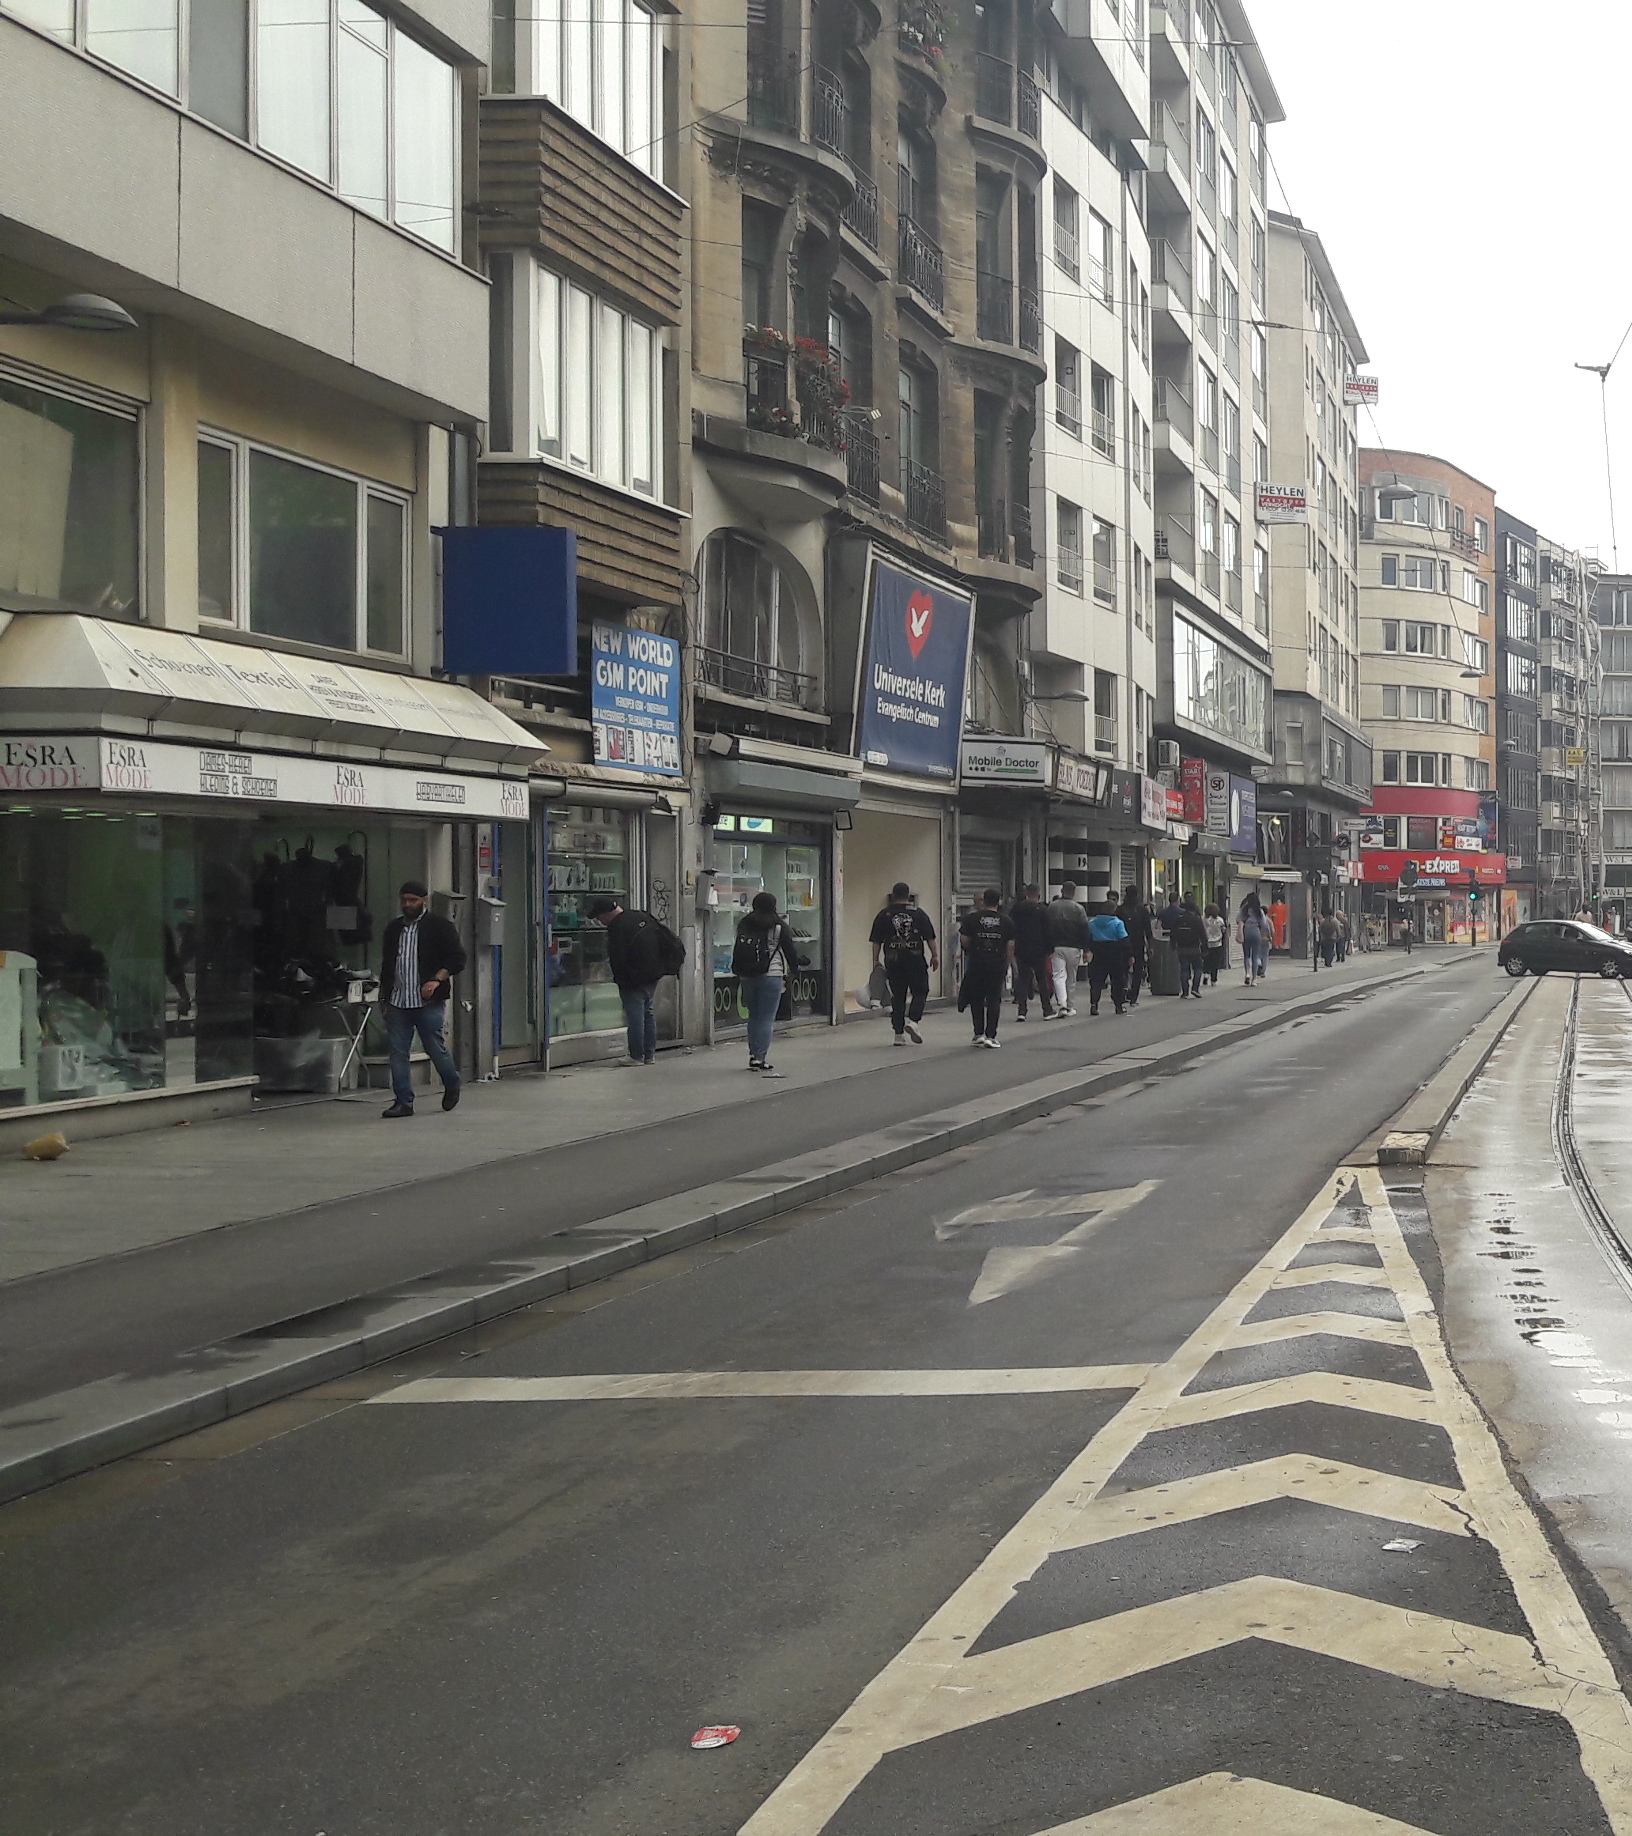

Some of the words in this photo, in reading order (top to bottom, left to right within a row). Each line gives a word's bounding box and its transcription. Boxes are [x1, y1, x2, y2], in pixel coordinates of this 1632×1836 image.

[1260, 485, 1304, 497] HEYLEN
[592, 625, 622, 656] NEW
[626, 633, 674, 668] WORLD
[134, 648, 221, 678] Schoenen
[220, 662, 298, 690] Textiel
[596, 658, 624, 690] GSM
[628, 666, 669, 699] POINT
[874, 663, 923, 702] Universele
[924, 679, 946, 709] Kerk
[877, 696, 914, 723] Evangelisch
[914, 706, 940, 728] Centrum
[6, 742, 77, 768] ESRA
[109, 741, 146, 768] ESRA
[968, 755, 1002, 767] Mobile
[1005, 757, 1039, 768] Doctor
[0, 765, 88, 789] MODE
[106, 764, 152, 789] MODE
[231, 775, 239, 795] &
[241, 776, 278, 798] SCHOENEN
[336, 765, 364, 789] ESRA
[332, 784, 368, 805] MODE
[501, 782, 524, 802] ESRA
[500, 798, 528, 817] MODE
